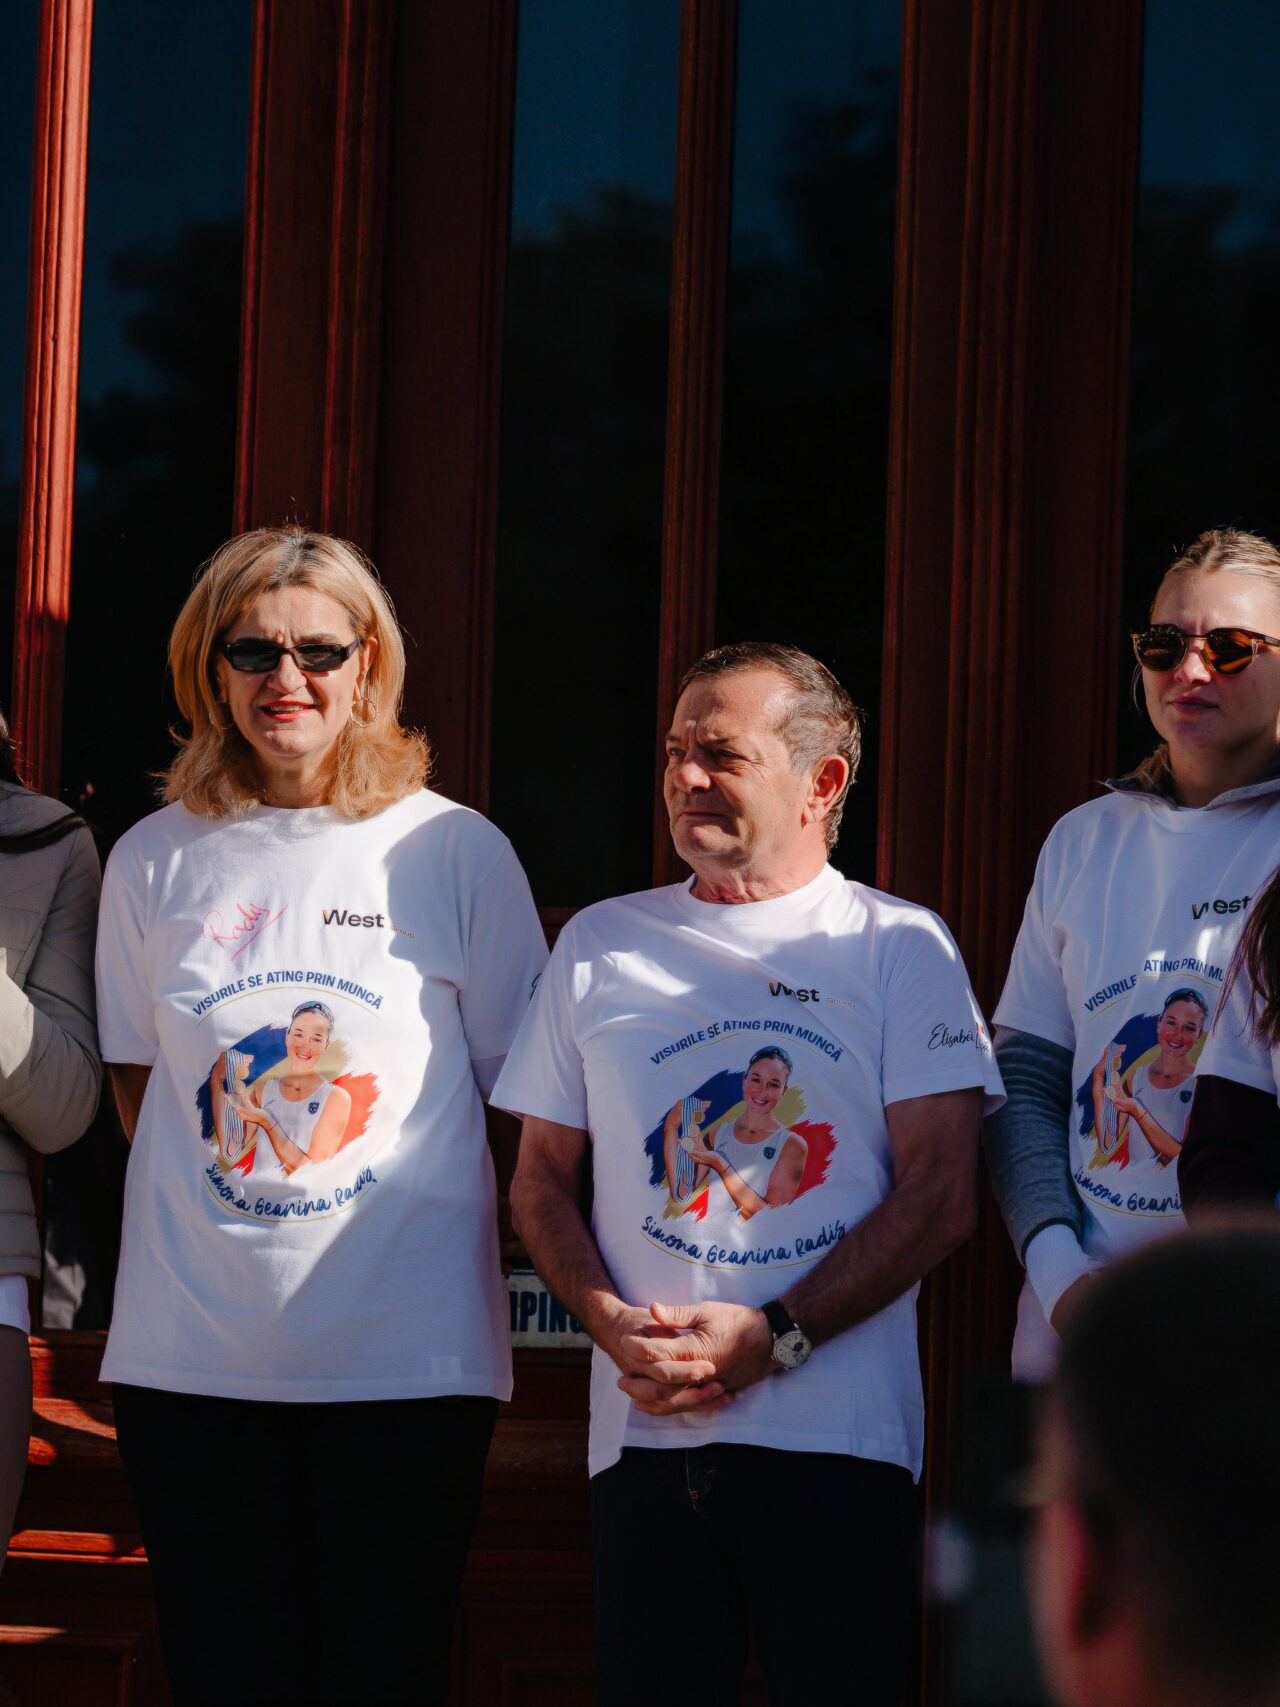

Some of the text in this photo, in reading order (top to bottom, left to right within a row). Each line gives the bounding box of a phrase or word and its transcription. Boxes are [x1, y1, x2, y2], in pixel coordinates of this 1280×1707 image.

[322, 909, 385, 928] West
[192, 971, 384, 1016] VISURILE SE ATING PRIN MUNCĂ
[1084, 974, 1138, 1012] VISURILE
[1143, 959, 1180, 972] ATING
[1181, 958, 1207, 975] PRIN
[650, 1020, 844, 1066] VISURILE SE ATING PRIN MUNCĂ
[205, 1163, 251, 1211] Simona
[255, 1197, 332, 1217] Geanina
[641, 1216, 703, 1260] Simona
[707, 1245, 791, 1265] Geanina
